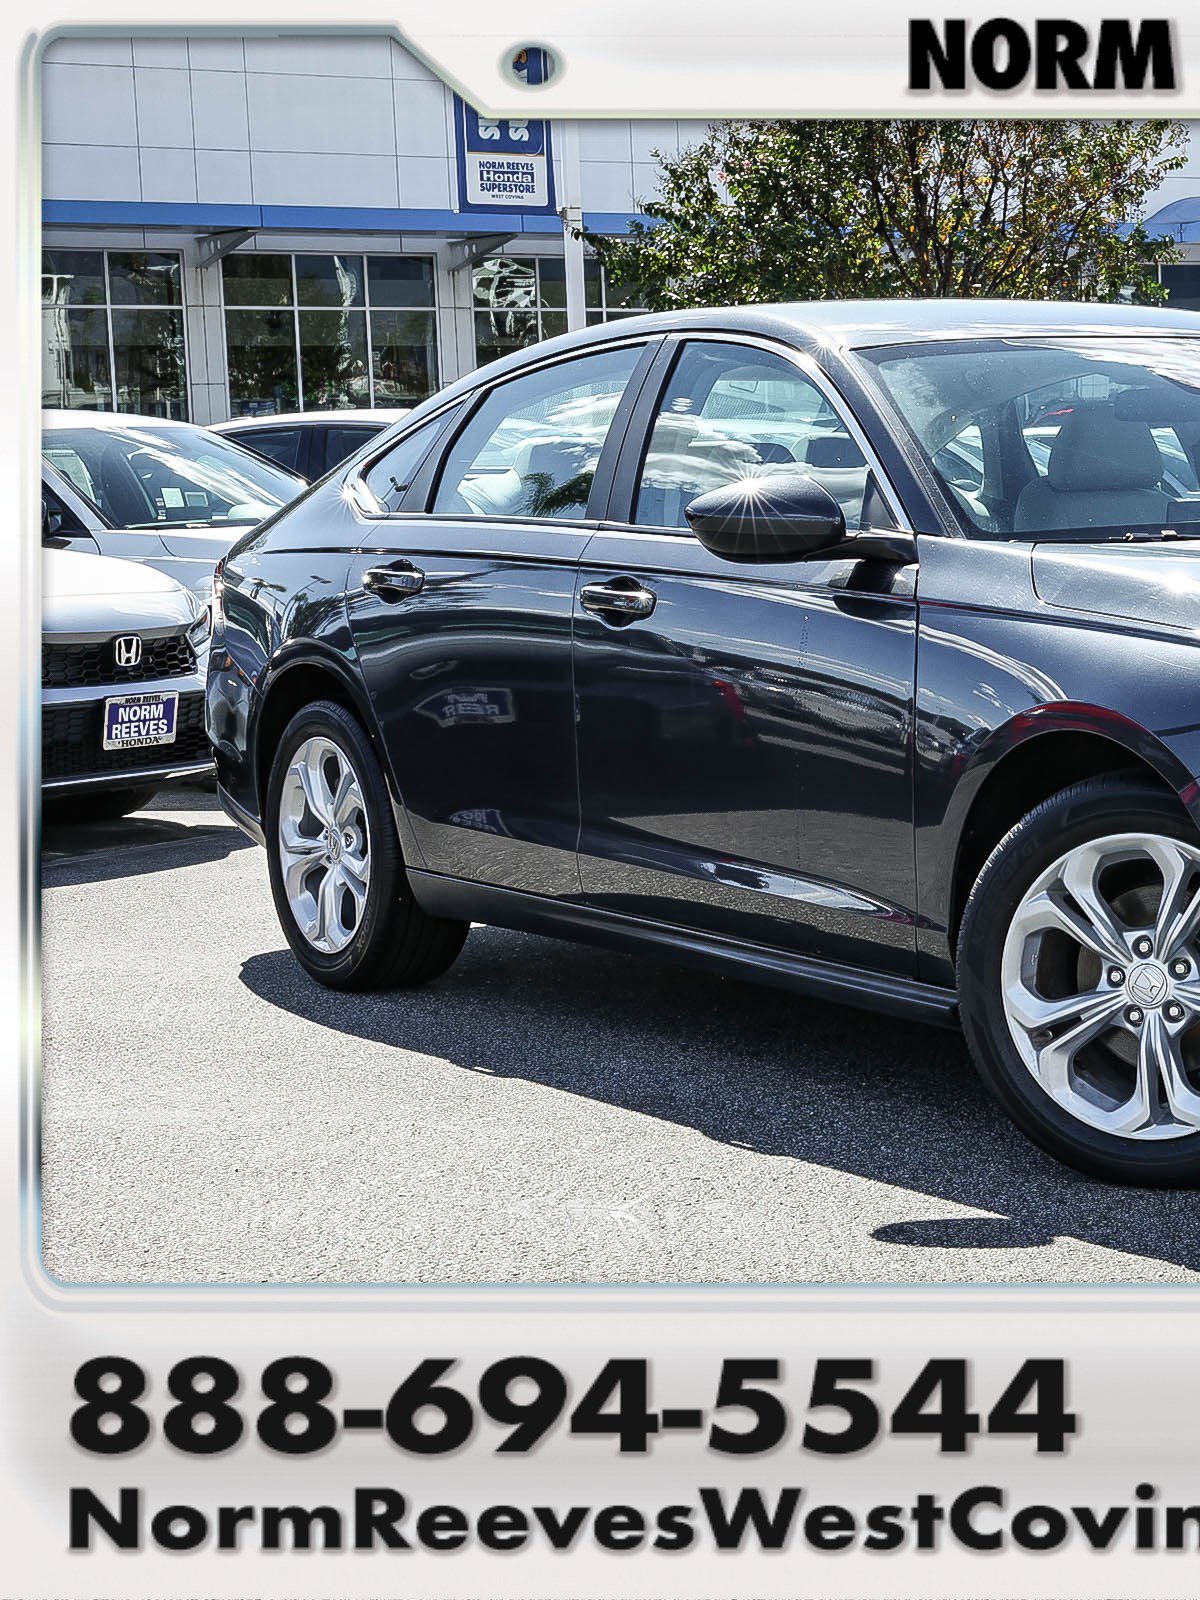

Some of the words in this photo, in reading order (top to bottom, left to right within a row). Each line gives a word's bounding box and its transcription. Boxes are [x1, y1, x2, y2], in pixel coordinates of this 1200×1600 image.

[478, 160, 505, 170] NORM
[506, 162, 534, 171] REEVES
[483, 170, 532, 182] Honda
[480, 183, 536, 194] SUPERSTORE
[118, 704, 164, 722] NORM
[111, 719, 168, 739] REEVES
[121, 736, 160, 747] HONDA
